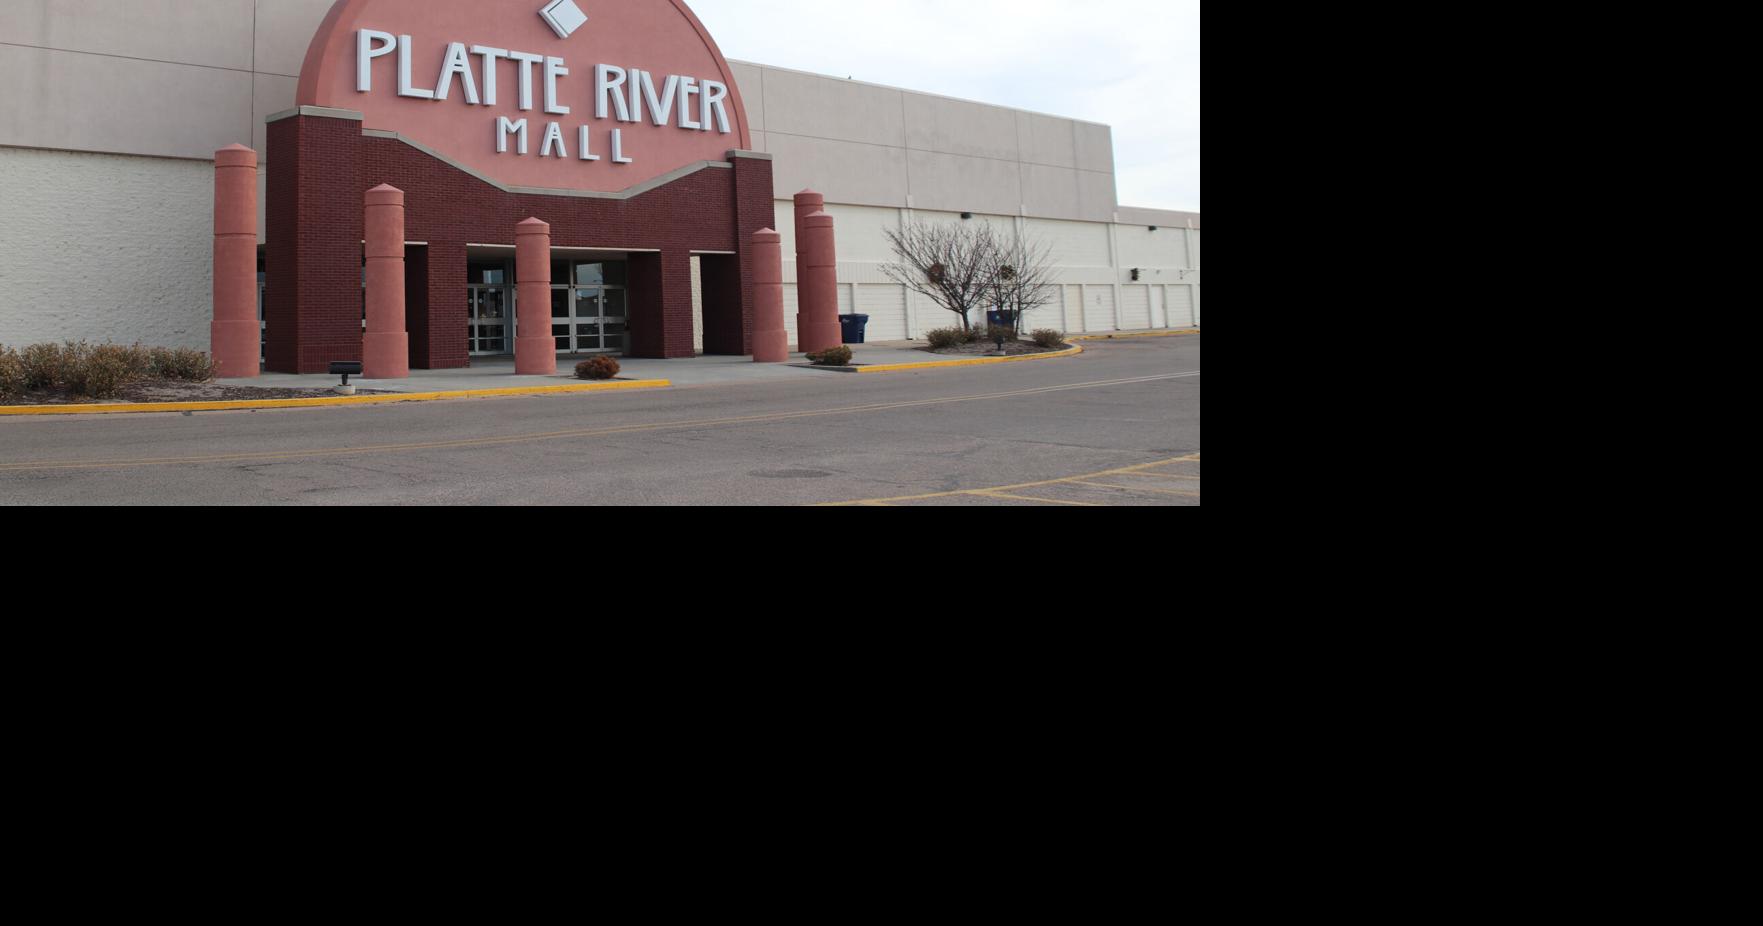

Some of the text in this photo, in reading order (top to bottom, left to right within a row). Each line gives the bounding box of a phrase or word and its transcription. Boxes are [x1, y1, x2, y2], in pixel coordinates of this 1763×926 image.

[356, 28, 731, 133] PLATTE RIVER
[496, 116, 632, 163] MALL
